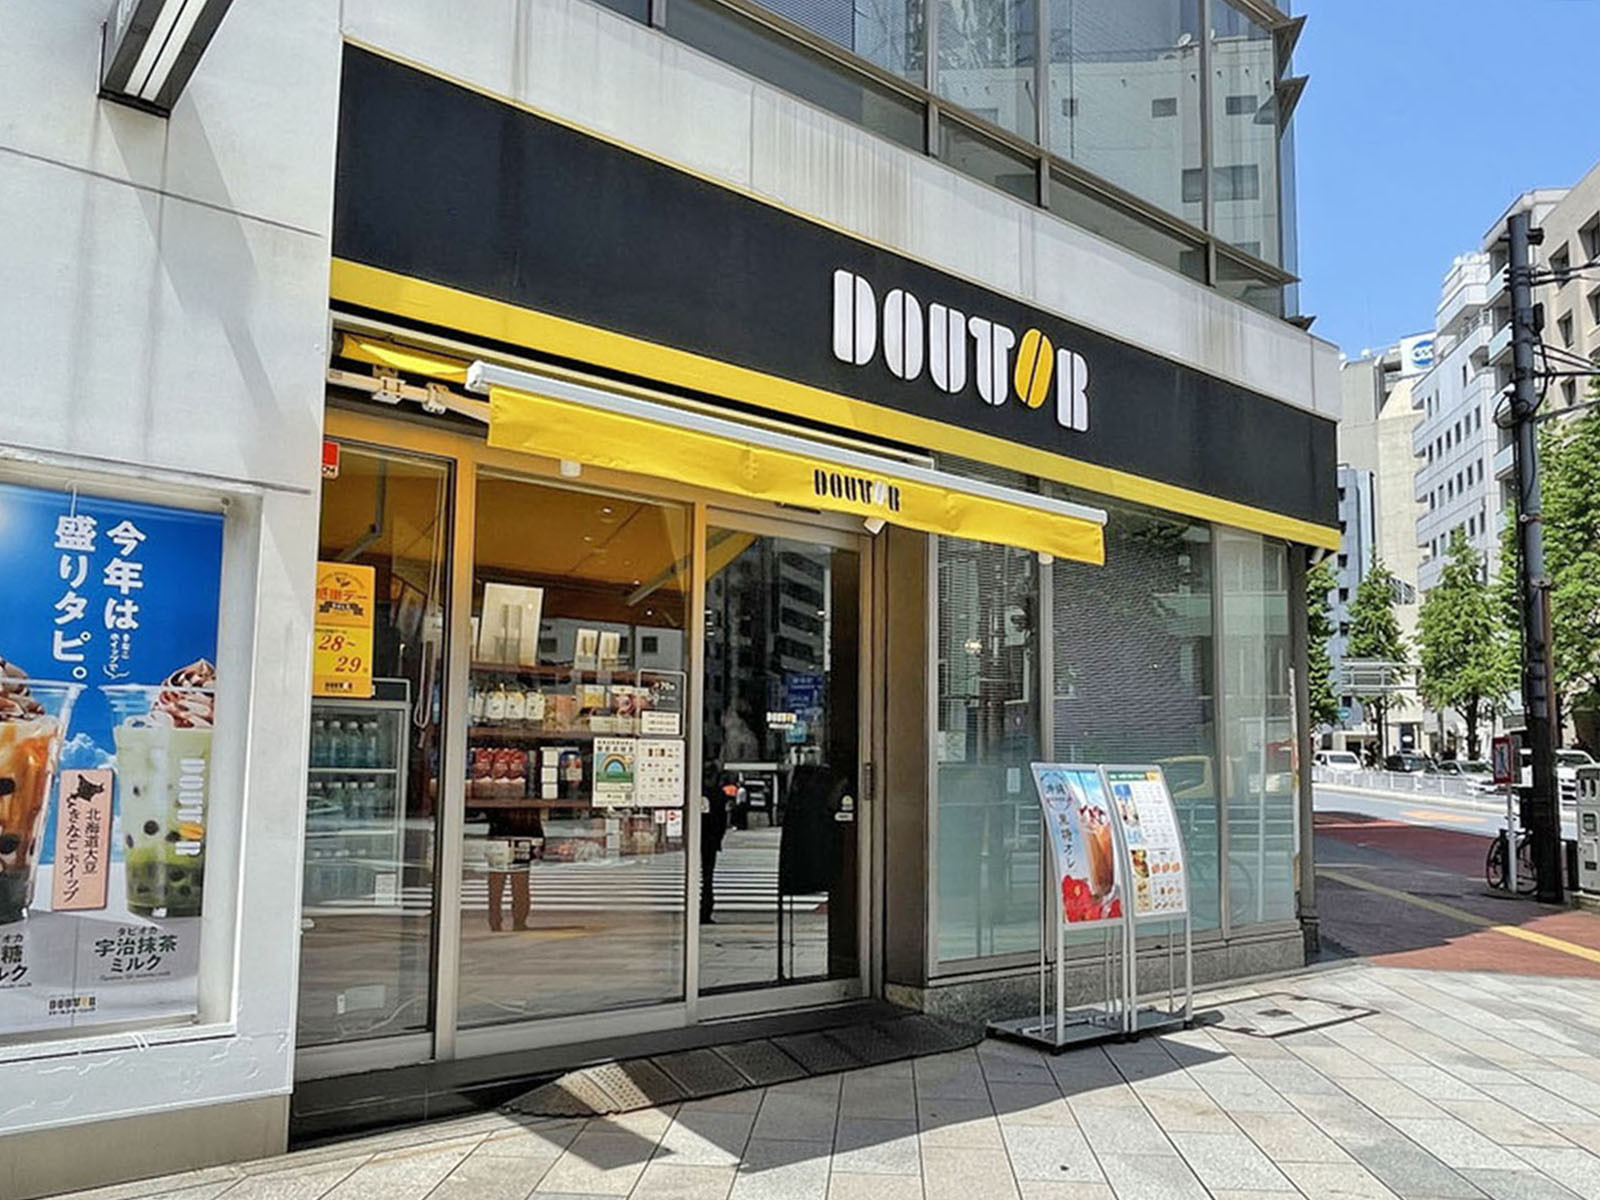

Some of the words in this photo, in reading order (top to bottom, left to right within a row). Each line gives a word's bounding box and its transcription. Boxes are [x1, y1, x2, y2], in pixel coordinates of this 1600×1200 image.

[833, 269, 1089, 432] DOUTOR
[814, 469, 900, 512] DOUTOR
[53, 514, 97, 680] 盛りタピ。
[103, 520, 147, 630] 今年は
[83, 808, 102, 875] 北海道大豆
[95, 935, 178, 957] 宇治抹茶
[111, 955, 162, 973] ミルク
